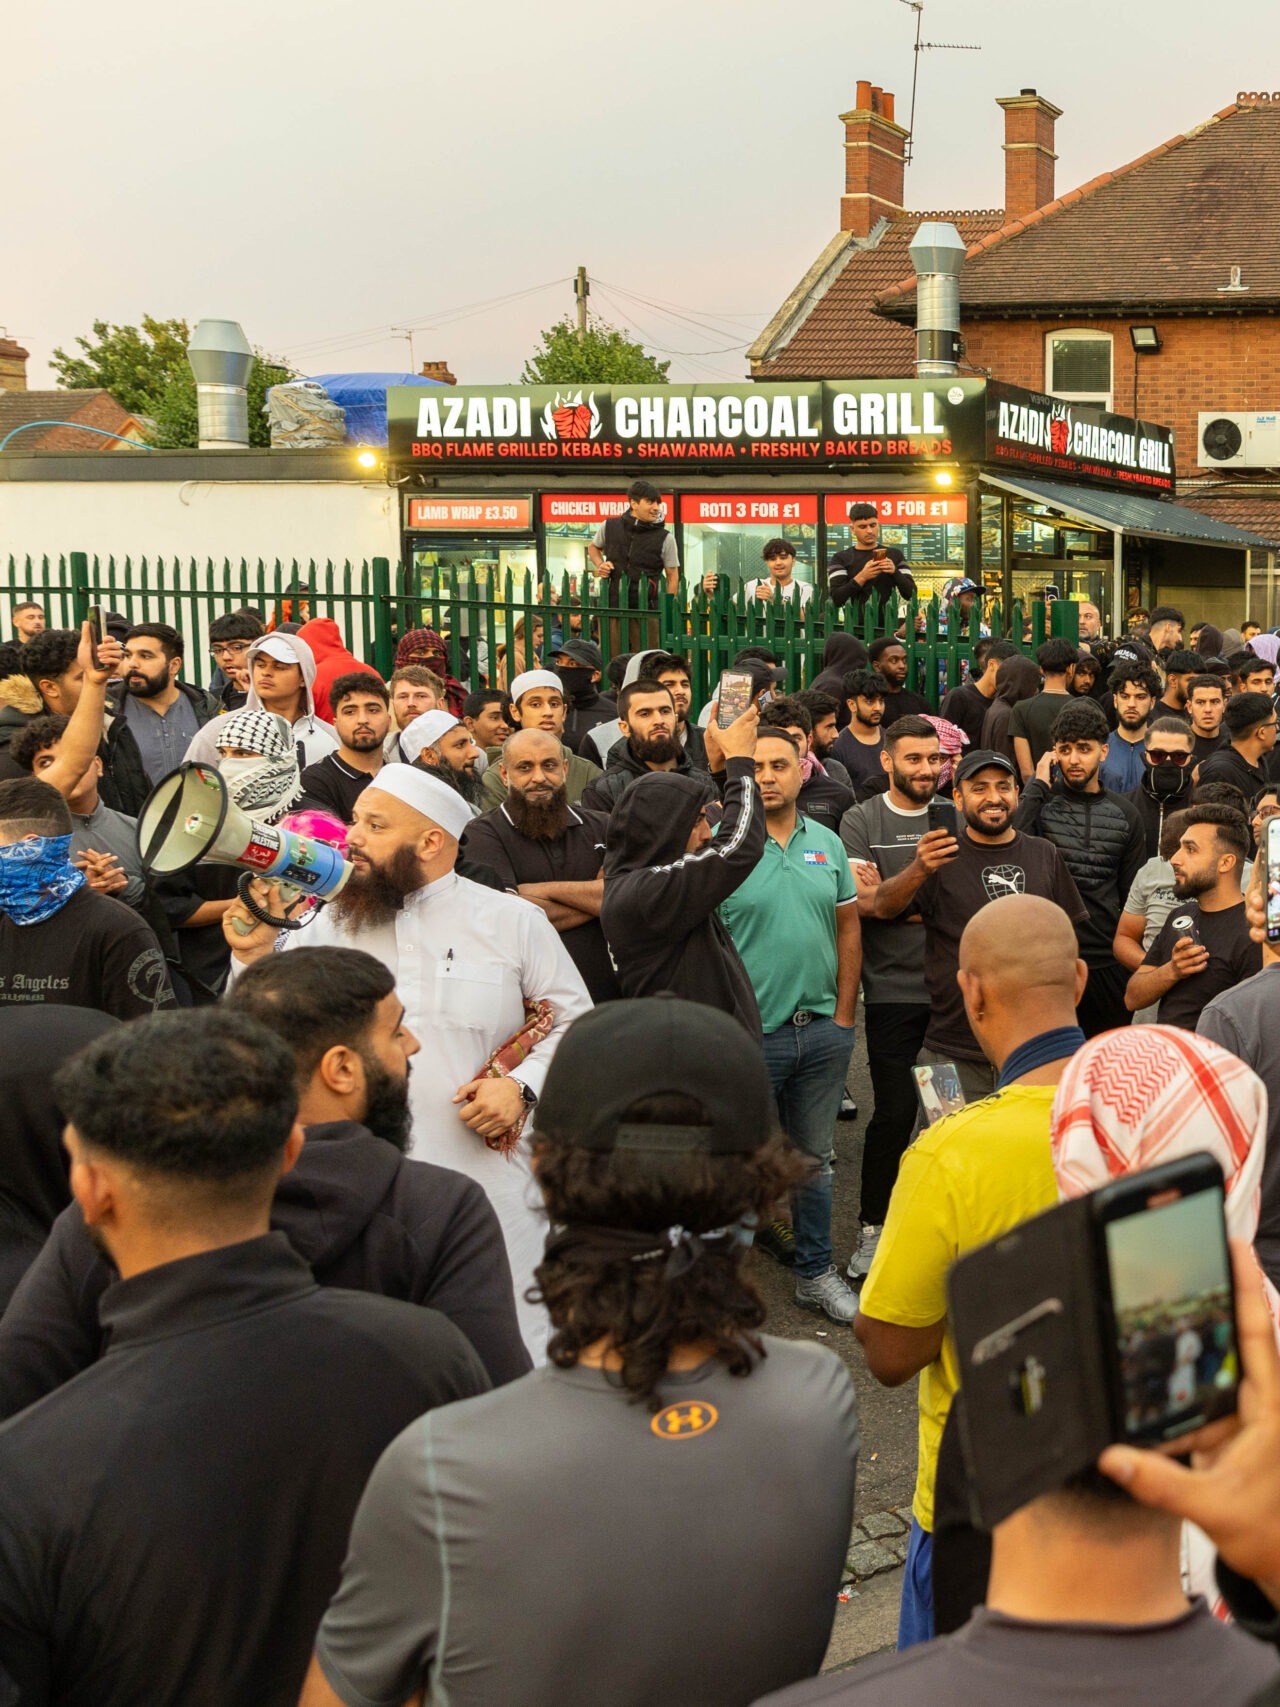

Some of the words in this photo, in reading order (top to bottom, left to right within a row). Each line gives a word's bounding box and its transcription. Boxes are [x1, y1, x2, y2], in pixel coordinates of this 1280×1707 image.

[416, 396, 532, 438] AZADI
[614, 394, 819, 439] CHARCOAL
[832, 391, 945, 435] GRILL
[998, 401, 1045, 447] AZADI
[1073, 421, 1138, 468] CHARCOAL
[1139, 437, 1172, 474] GRILL
[411, 442, 444, 460] BBQ
[445, 442, 495, 458] FLAME
[497, 443, 559, 458] GRILLED
[561, 442, 623, 458] KEBABS
[637, 442, 736, 459] SHAWARMA
[751, 442, 821, 459] FRESHLY
[824, 440, 883, 456] BAKED
[886, 439, 953, 455] BREADS
[417, 505, 447, 521] LAMB
[449, 505, 482, 520] WRAP
[484, 505, 518, 520] £3.50
[550, 501, 597, 516] CHICKEN
[699, 502, 732, 518] ROTI
[735, 502, 747, 517] 3
[750, 502, 778, 518] FOR
[782, 502, 801, 517] £1
[881, 501, 892, 516] 3
[896, 500, 926, 517] FOR
[929, 500, 949, 516] £1
[251, 833, 280, 851] PALESTINE
[11, 973, 71, 993] Angeles
